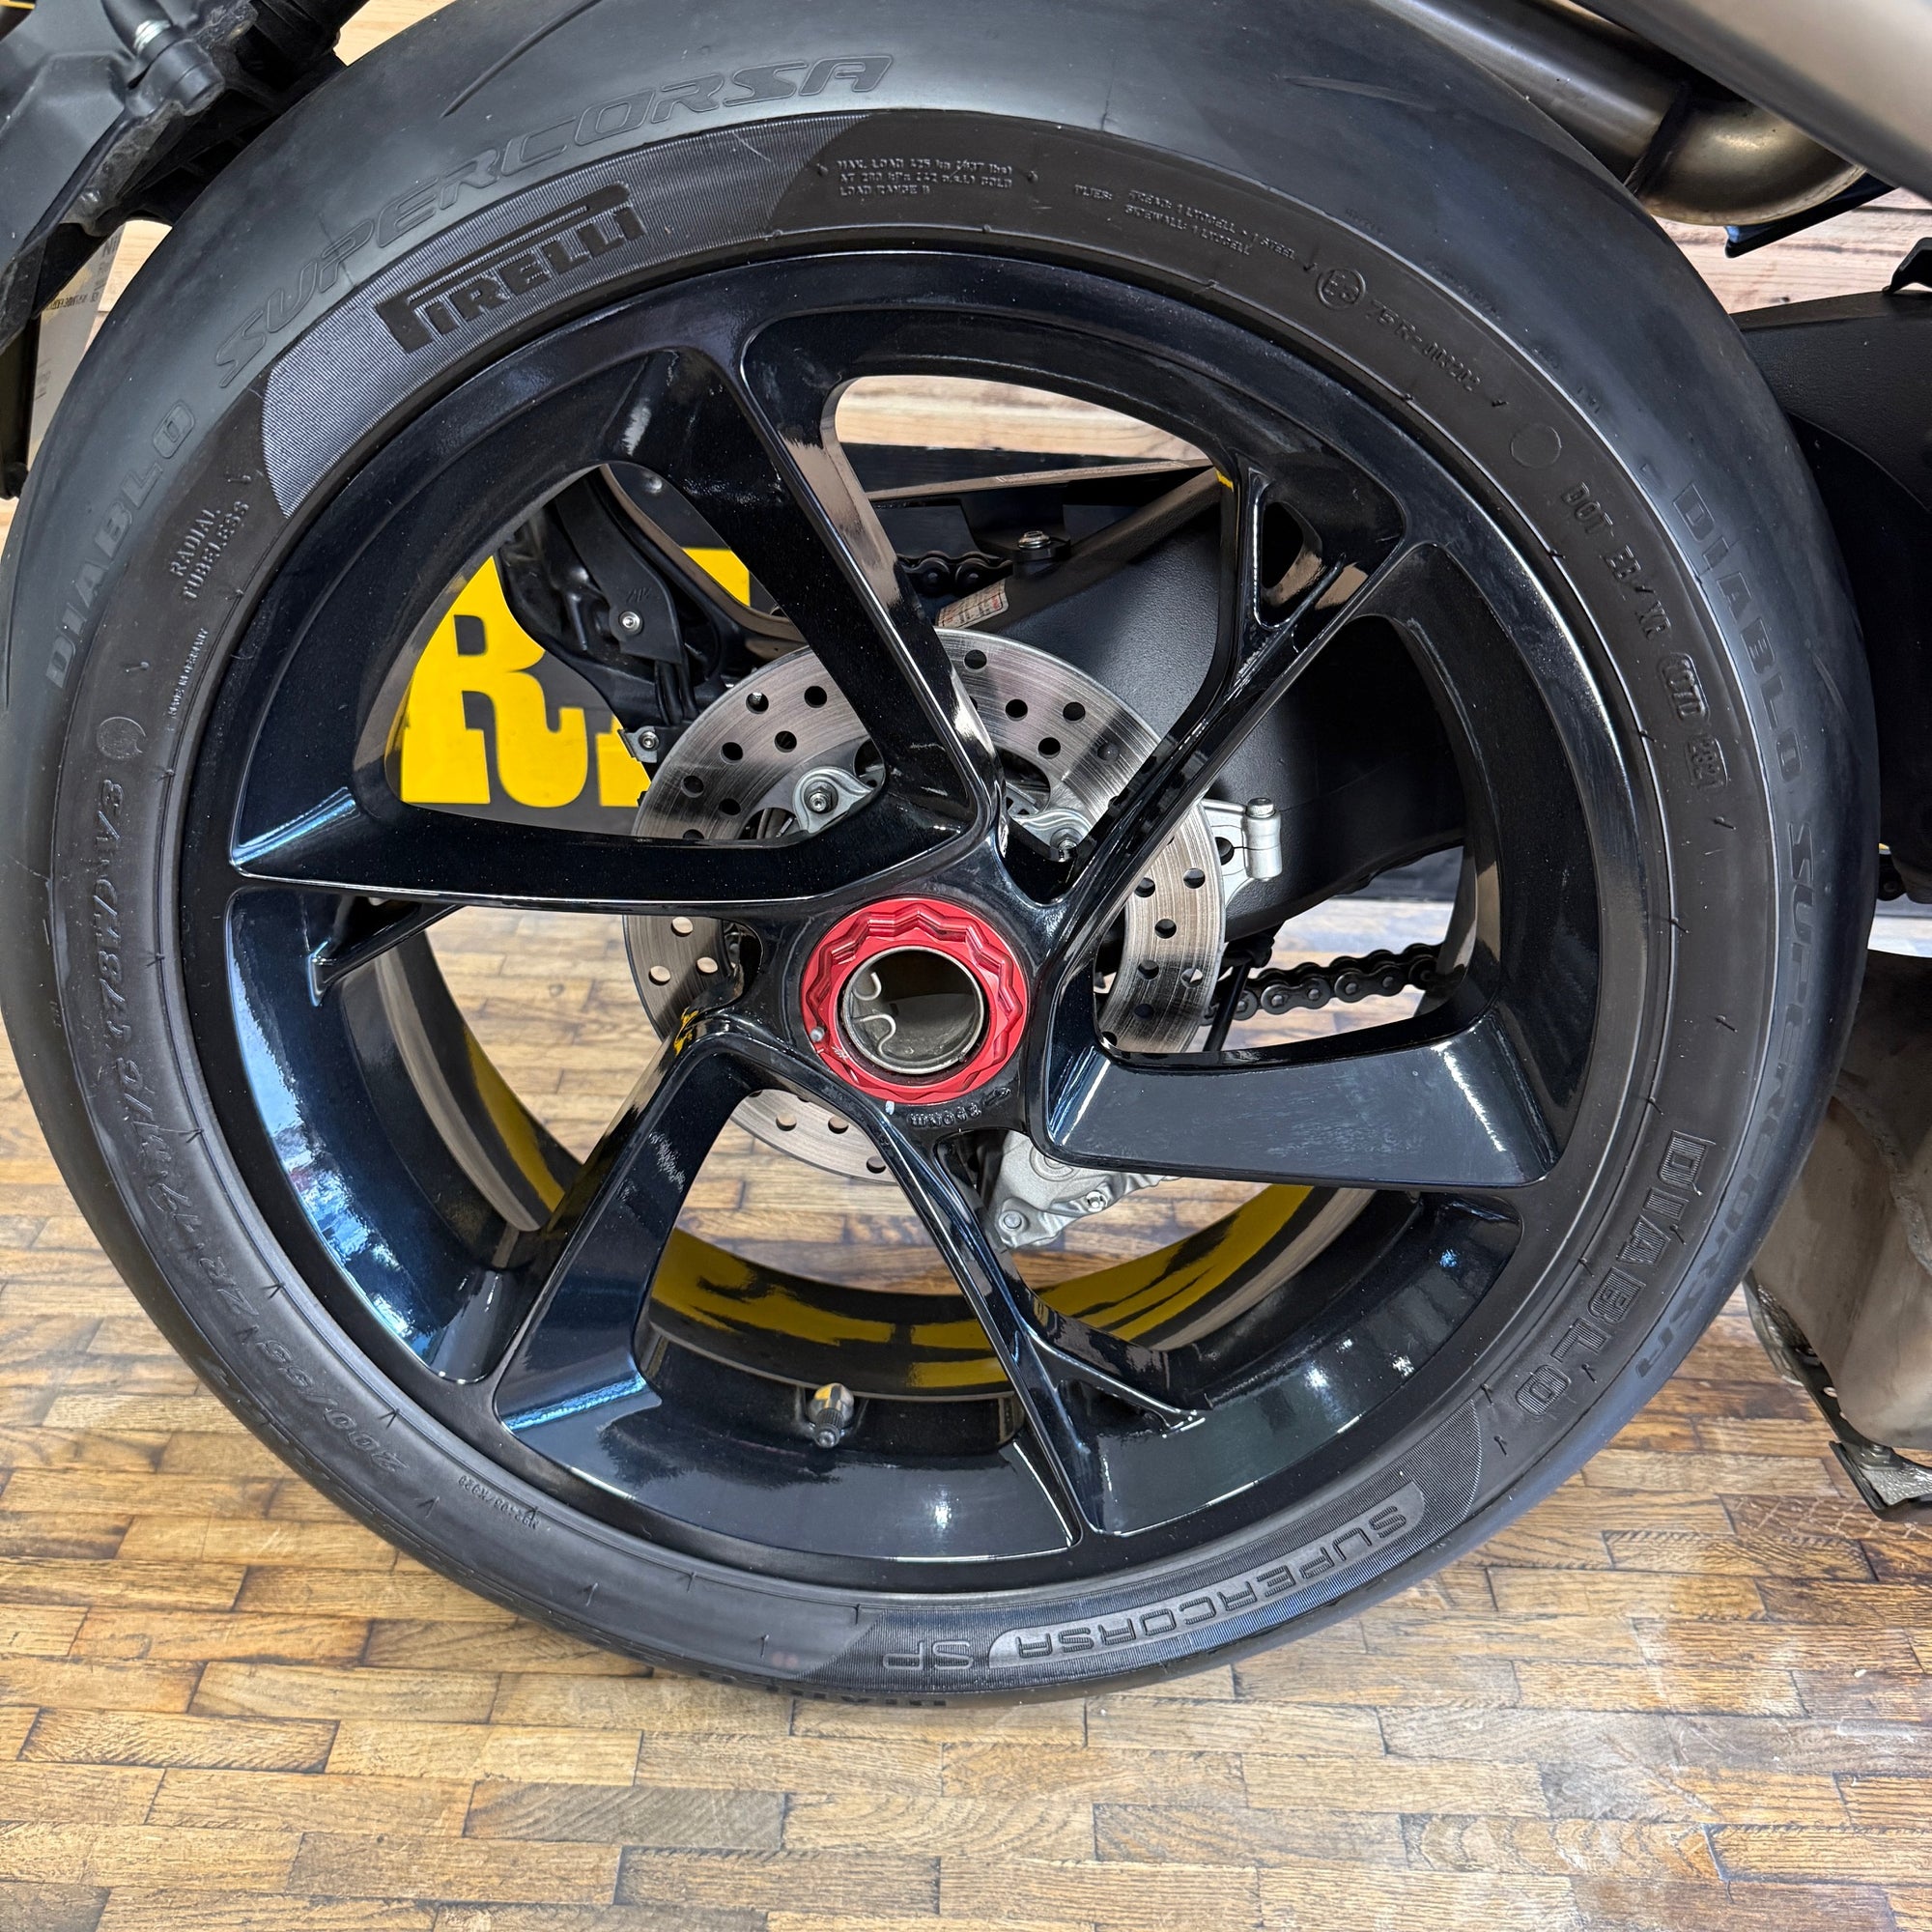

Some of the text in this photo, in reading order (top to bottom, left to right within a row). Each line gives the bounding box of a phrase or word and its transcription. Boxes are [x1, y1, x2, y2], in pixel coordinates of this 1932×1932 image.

[839, 172, 856, 183] AT
[839, 185, 872, 196] LOAD
[876, 185, 918, 195] RANGE
[871, 157, 904, 169] LOAD
[376, 181, 647, 354] PIRELLI
[45, 55, 893, 689] DIABLO SUPERCORSA
[168, 506, 221, 577] RADIAL
[183, 497, 250, 598] TUBELESS
[1559, 478, 1614, 535] DOT
[1672, 483, 1804, 784] DIABLO
[256, 1339, 411, 1473] 200/55
[882, 1129, 1713, 1672] DIABLO SUPERCORSA SP
